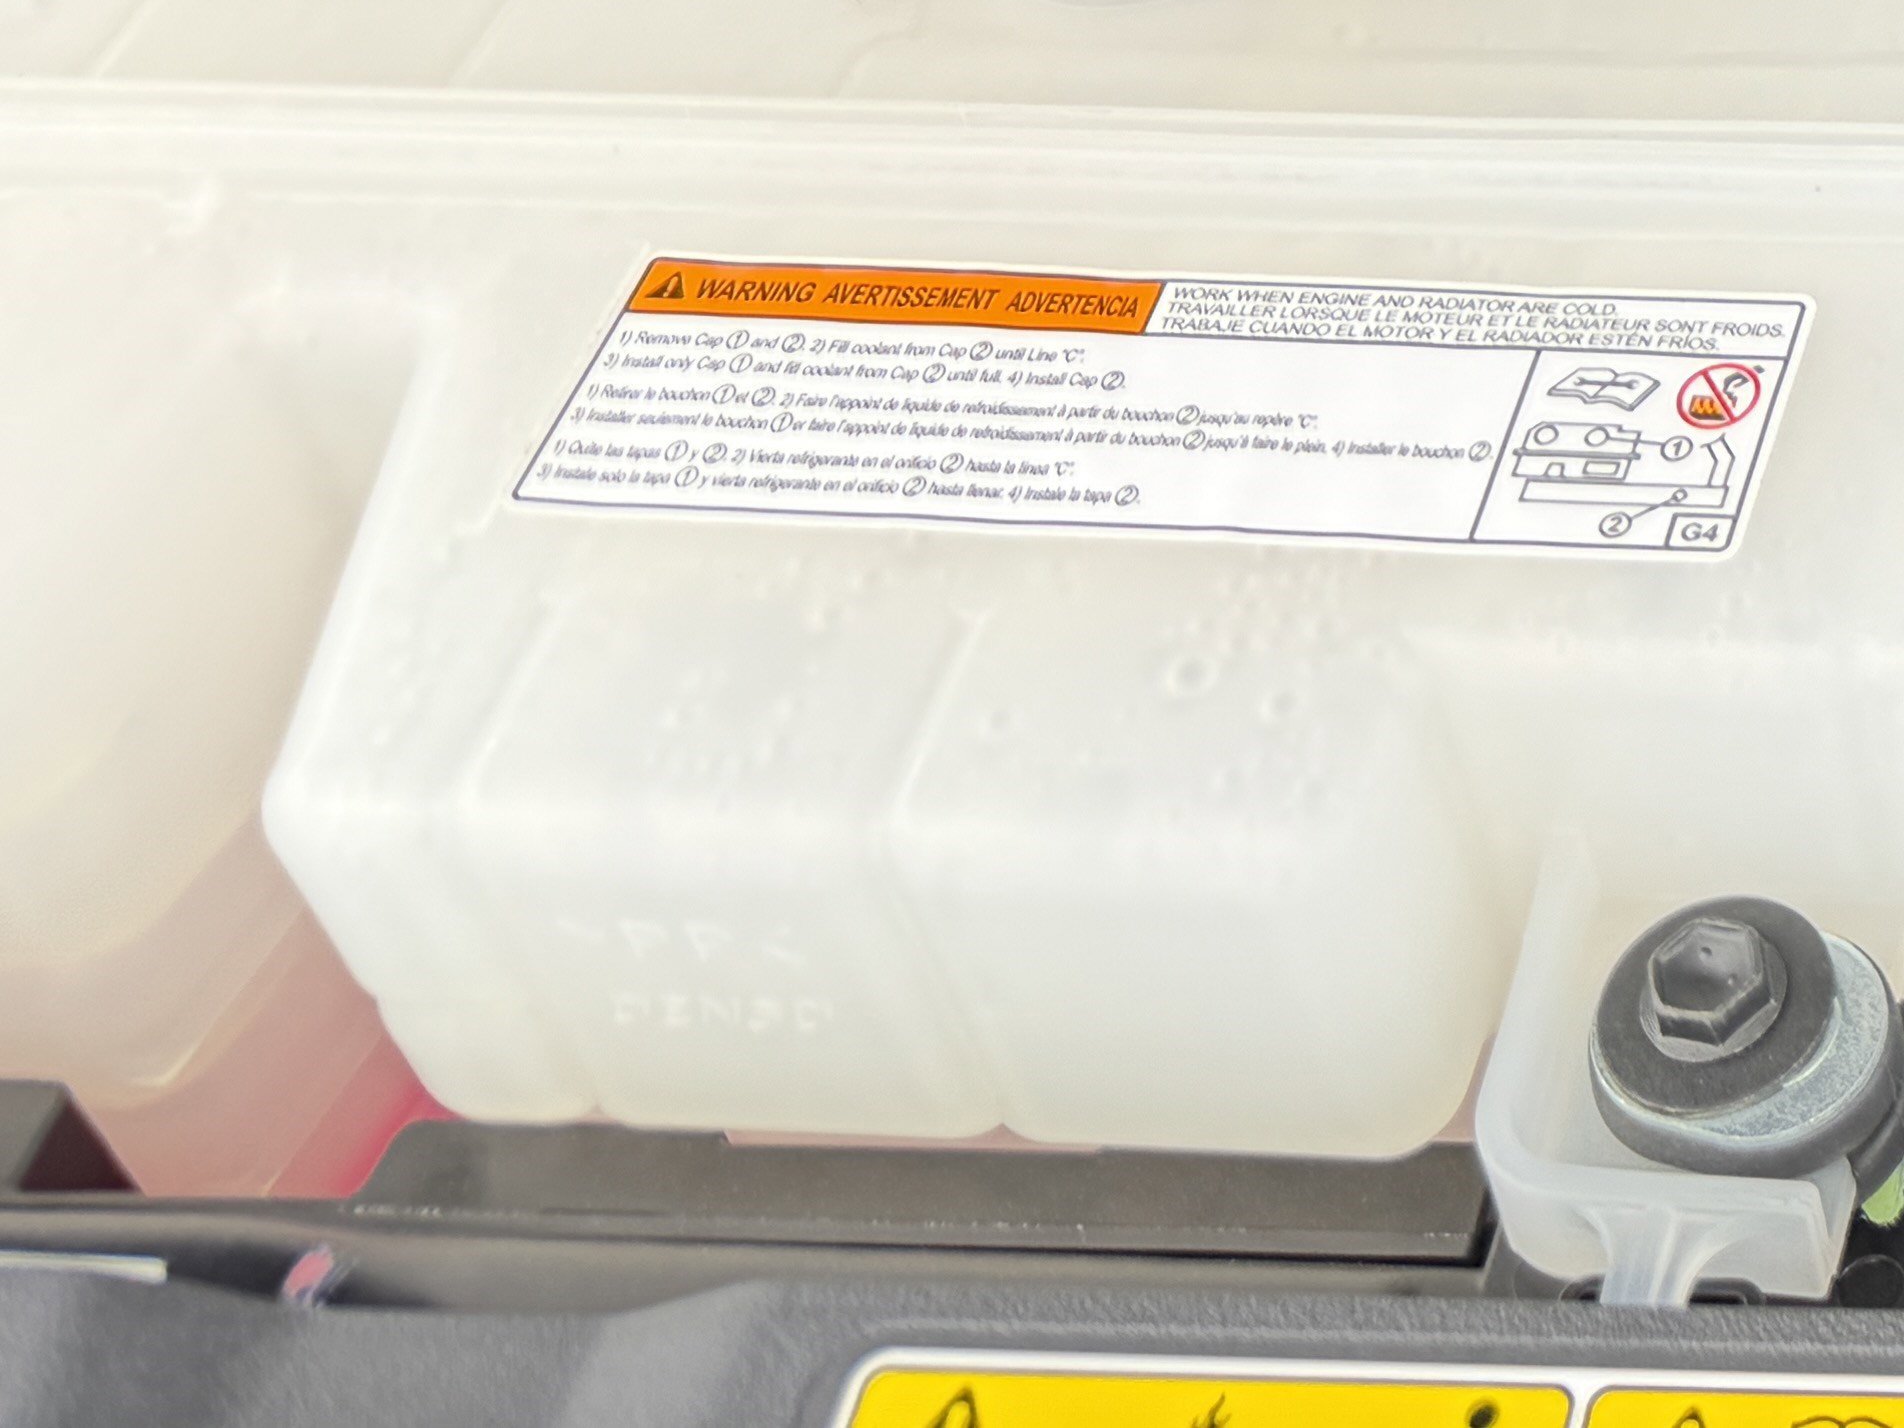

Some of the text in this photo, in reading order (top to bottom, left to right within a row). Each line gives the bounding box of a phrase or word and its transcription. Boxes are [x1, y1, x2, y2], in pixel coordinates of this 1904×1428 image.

[697, 279, 1139, 320] WARNING AVERTISSEMENT ADVERTENCIA
[1174, 286, 1618, 316] WORK WHEN ENGINE AND RADIATOR ARE COLD.
[1161, 317, 1244, 333] TRABAJE
[1249, 320, 1330, 336] CUANDO
[1335, 323, 1357, 337] EL
[1362, 325, 1435, 340] MOTOR
[1440, 328, 1452, 340] Y
[1455, 329, 1478, 342] EL
[1483, 329, 1584, 345] RADIADOR
[1168, 301, 1785, 338] TRAVAILLER LORSQUE LE MOTEUR ET LE RADIATEUR SONT FROIDS.
[1681, 521, 1719, 544] G4
